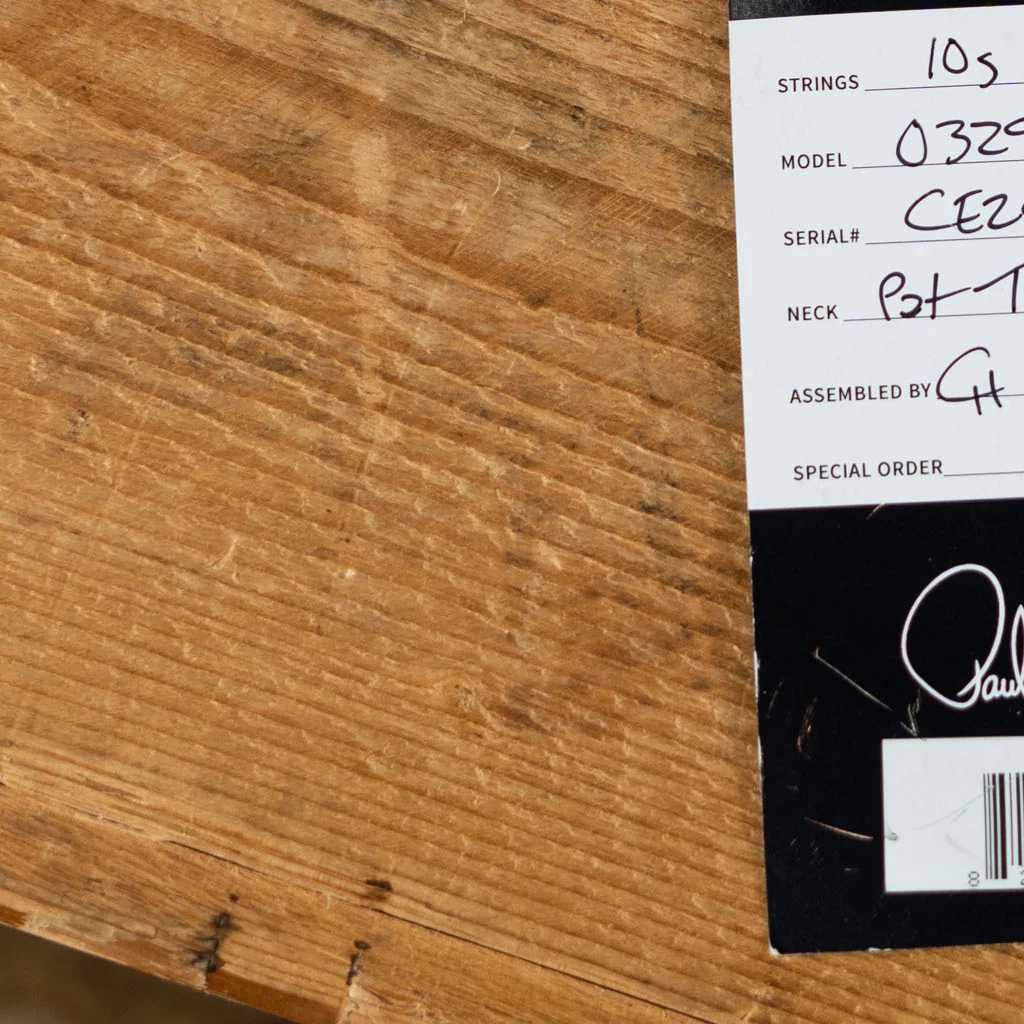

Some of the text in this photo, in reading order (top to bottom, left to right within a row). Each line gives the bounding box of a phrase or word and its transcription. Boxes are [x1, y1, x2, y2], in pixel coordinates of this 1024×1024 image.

[777, 77, 860, 93] STRINGS
[781, 152, 848, 170] MODEL
[783, 228, 861, 246] SERIAL#
[787, 304, 838, 322] NECK
[790, 383, 932, 404] ASSEMBLED BY
[793, 459, 943, 481] SPECIAL ORDER
[967, 870, 980, 887] 8
